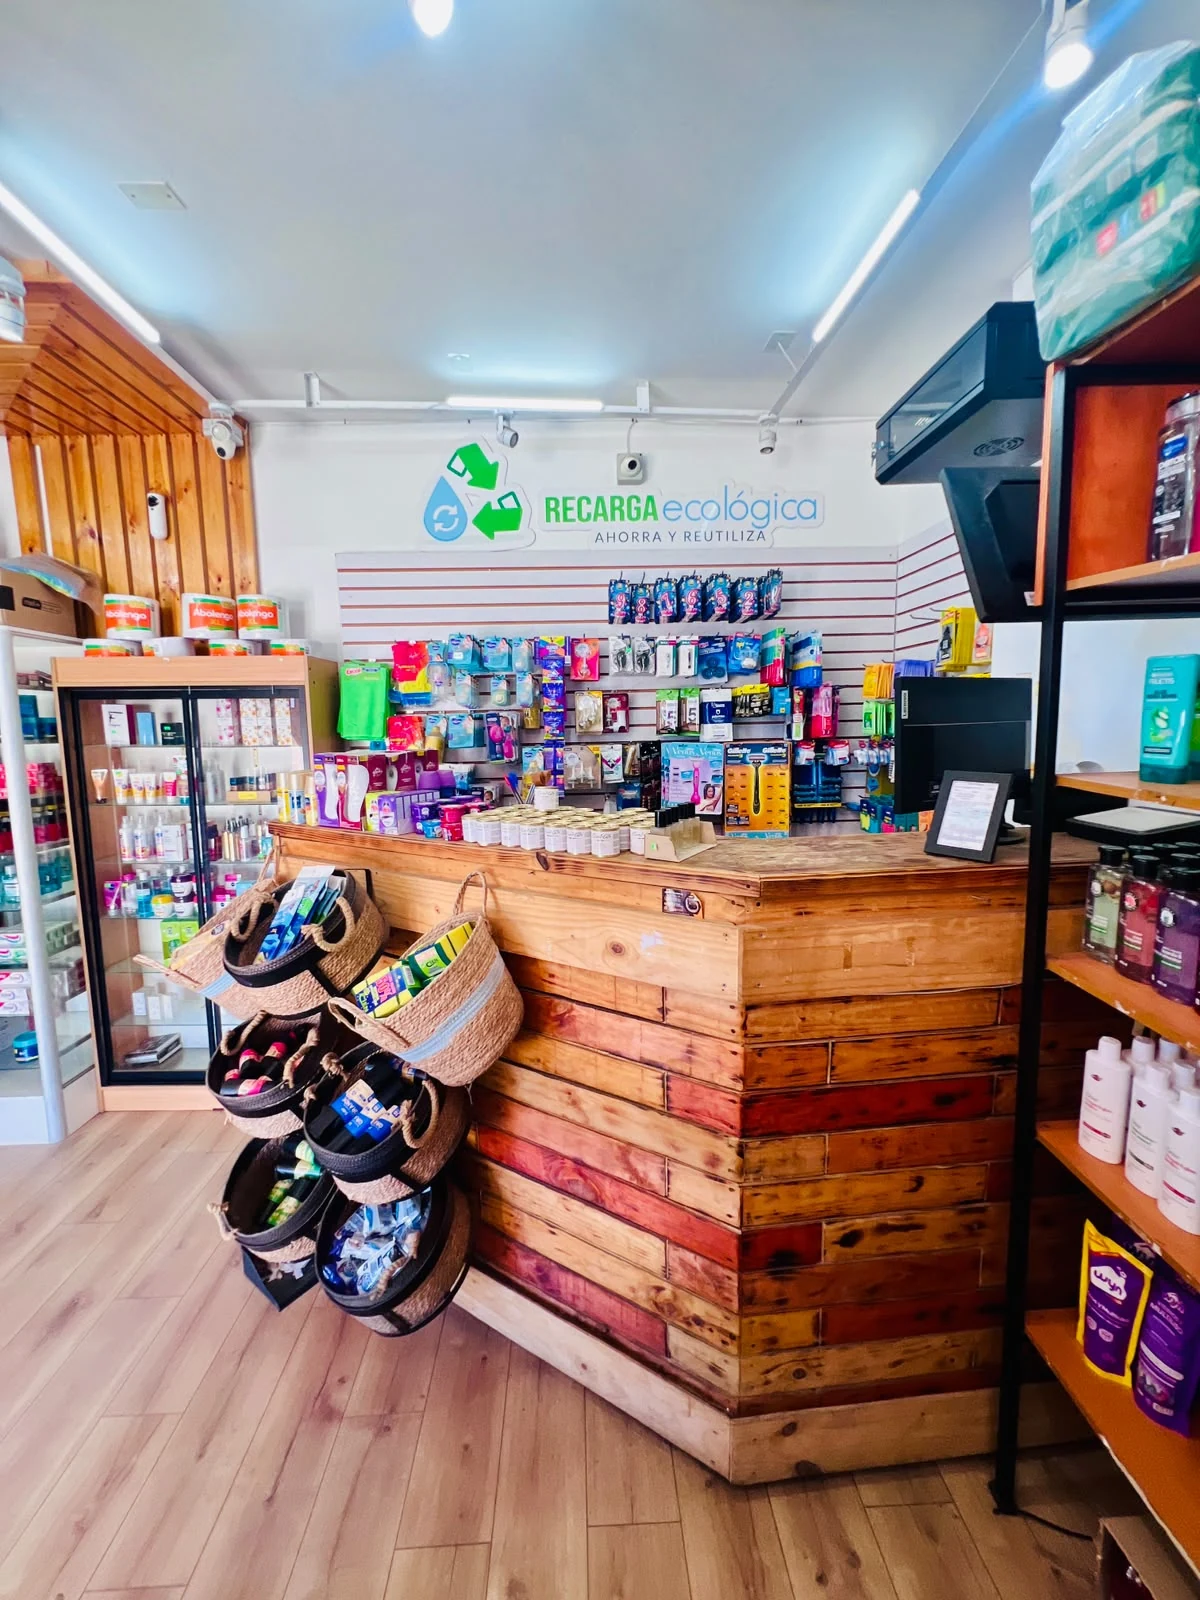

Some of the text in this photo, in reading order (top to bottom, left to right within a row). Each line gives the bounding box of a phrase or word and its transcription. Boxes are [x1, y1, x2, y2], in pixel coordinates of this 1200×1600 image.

[544, 485, 817, 529] RECARGA ecológica
[595, 530, 766, 543] AHORRA Y REUTILIZA
[615, 593, 627, 609] 9
[686, 589, 700, 606] 6
[715, 588, 728, 604] 5
[744, 591, 755, 606] 2
[636, 598, 647, 614] 8
